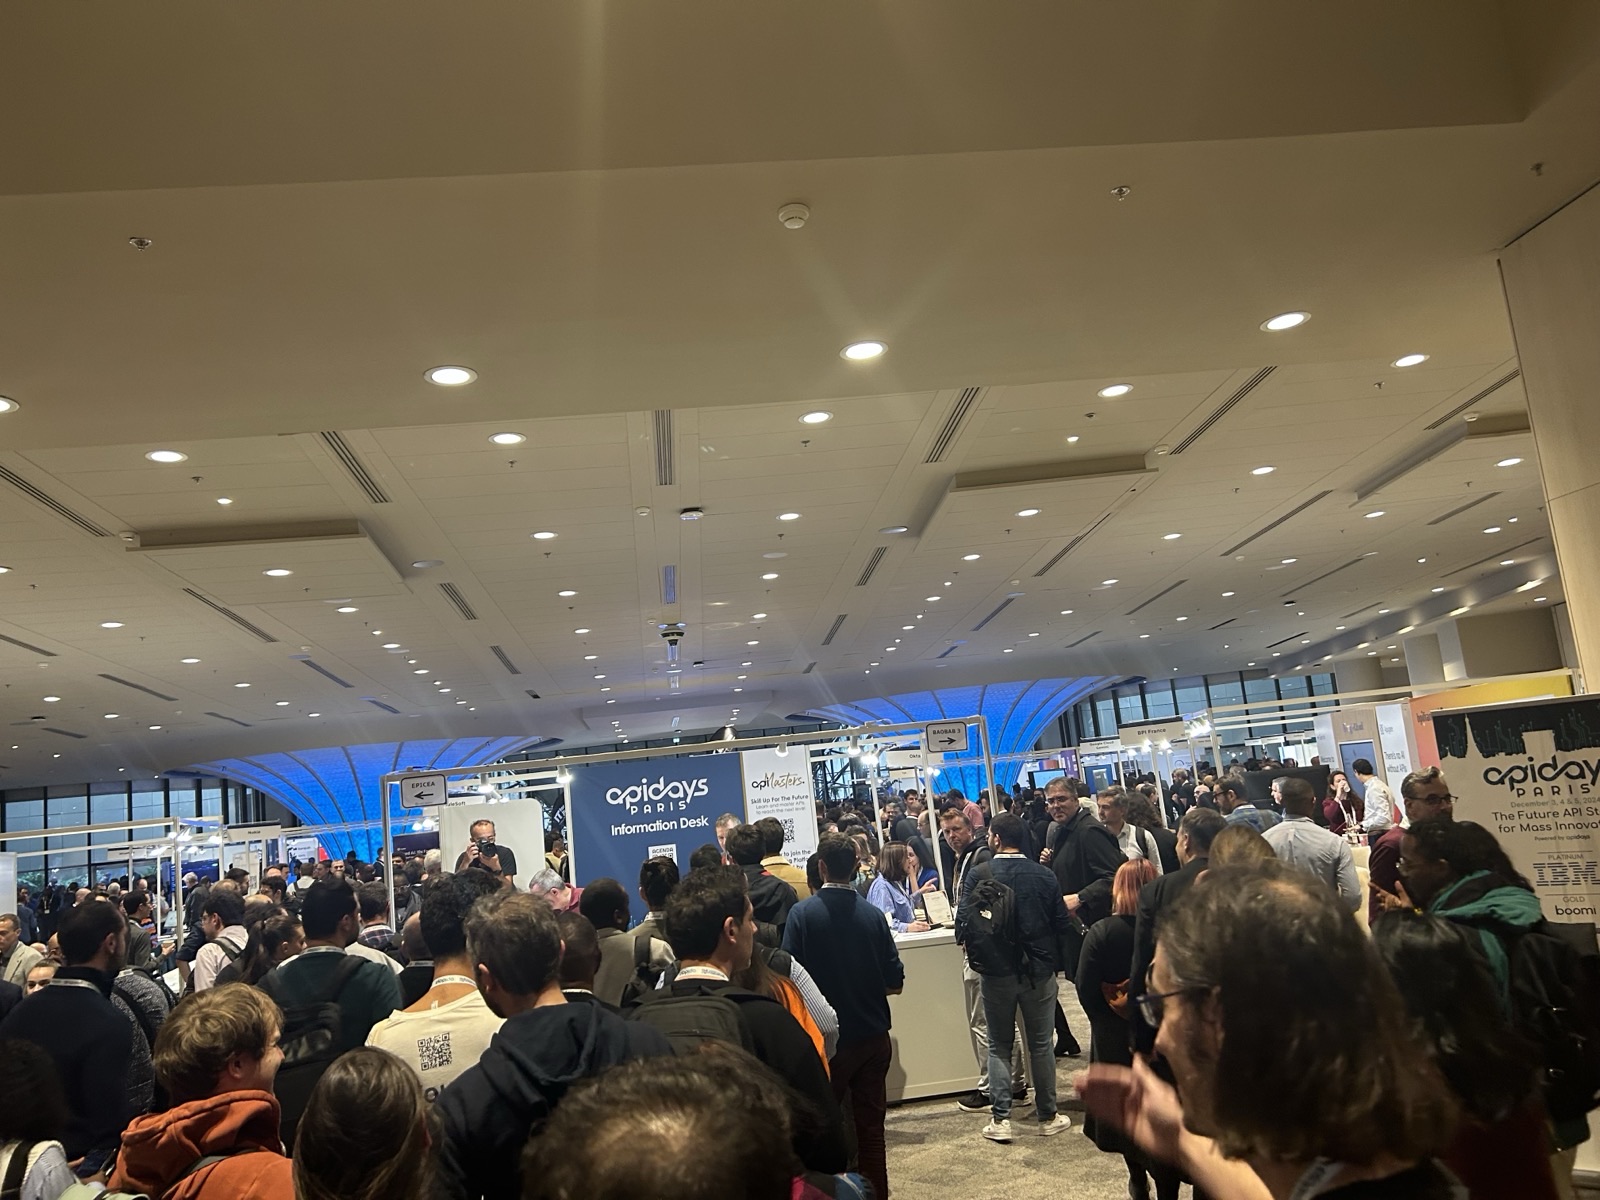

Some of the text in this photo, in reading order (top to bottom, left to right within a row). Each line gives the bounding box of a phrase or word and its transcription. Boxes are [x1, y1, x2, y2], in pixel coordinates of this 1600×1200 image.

[411, 781, 436, 789] EPICEA
[1516, 783, 1591, 798] PARIS
[605, 776, 709, 810] apidays
[630, 801, 687, 815] PARIS
[1510, 800, 1549, 808] December
[1491, 806, 1600, 821] The Future API St
[611, 815, 709, 836] Information Desk
[1498, 823, 1516, 833] for
[1520, 823, 1553, 832] Mass
[1532, 861, 1600, 887] IBM
[1554, 905, 1597, 915] boomi
